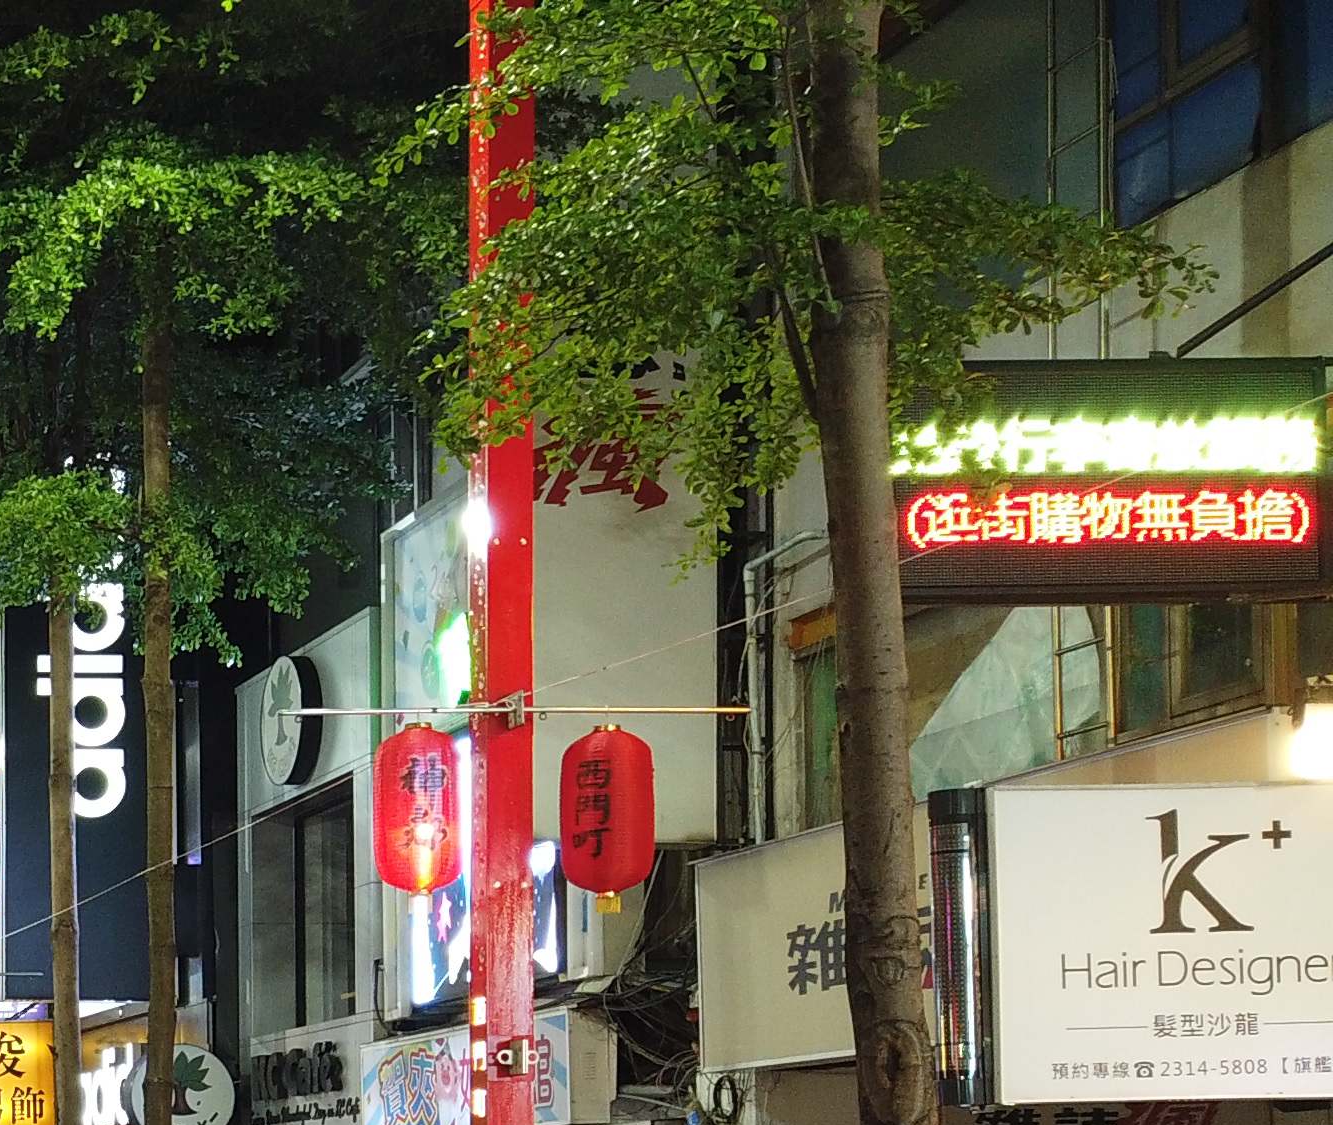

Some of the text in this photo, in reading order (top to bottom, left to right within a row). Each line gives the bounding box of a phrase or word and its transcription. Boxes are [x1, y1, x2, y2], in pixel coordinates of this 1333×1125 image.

[573, 759, 611, 858] 西門町
[1061, 948, 1333, 996] Hair Designe
[1152, 1012, 1259, 1038] 髮型沙龍
[1052, 1061, 1130, 1080] 預約專線
[1160, 1058, 1268, 1077] 2314-5808
